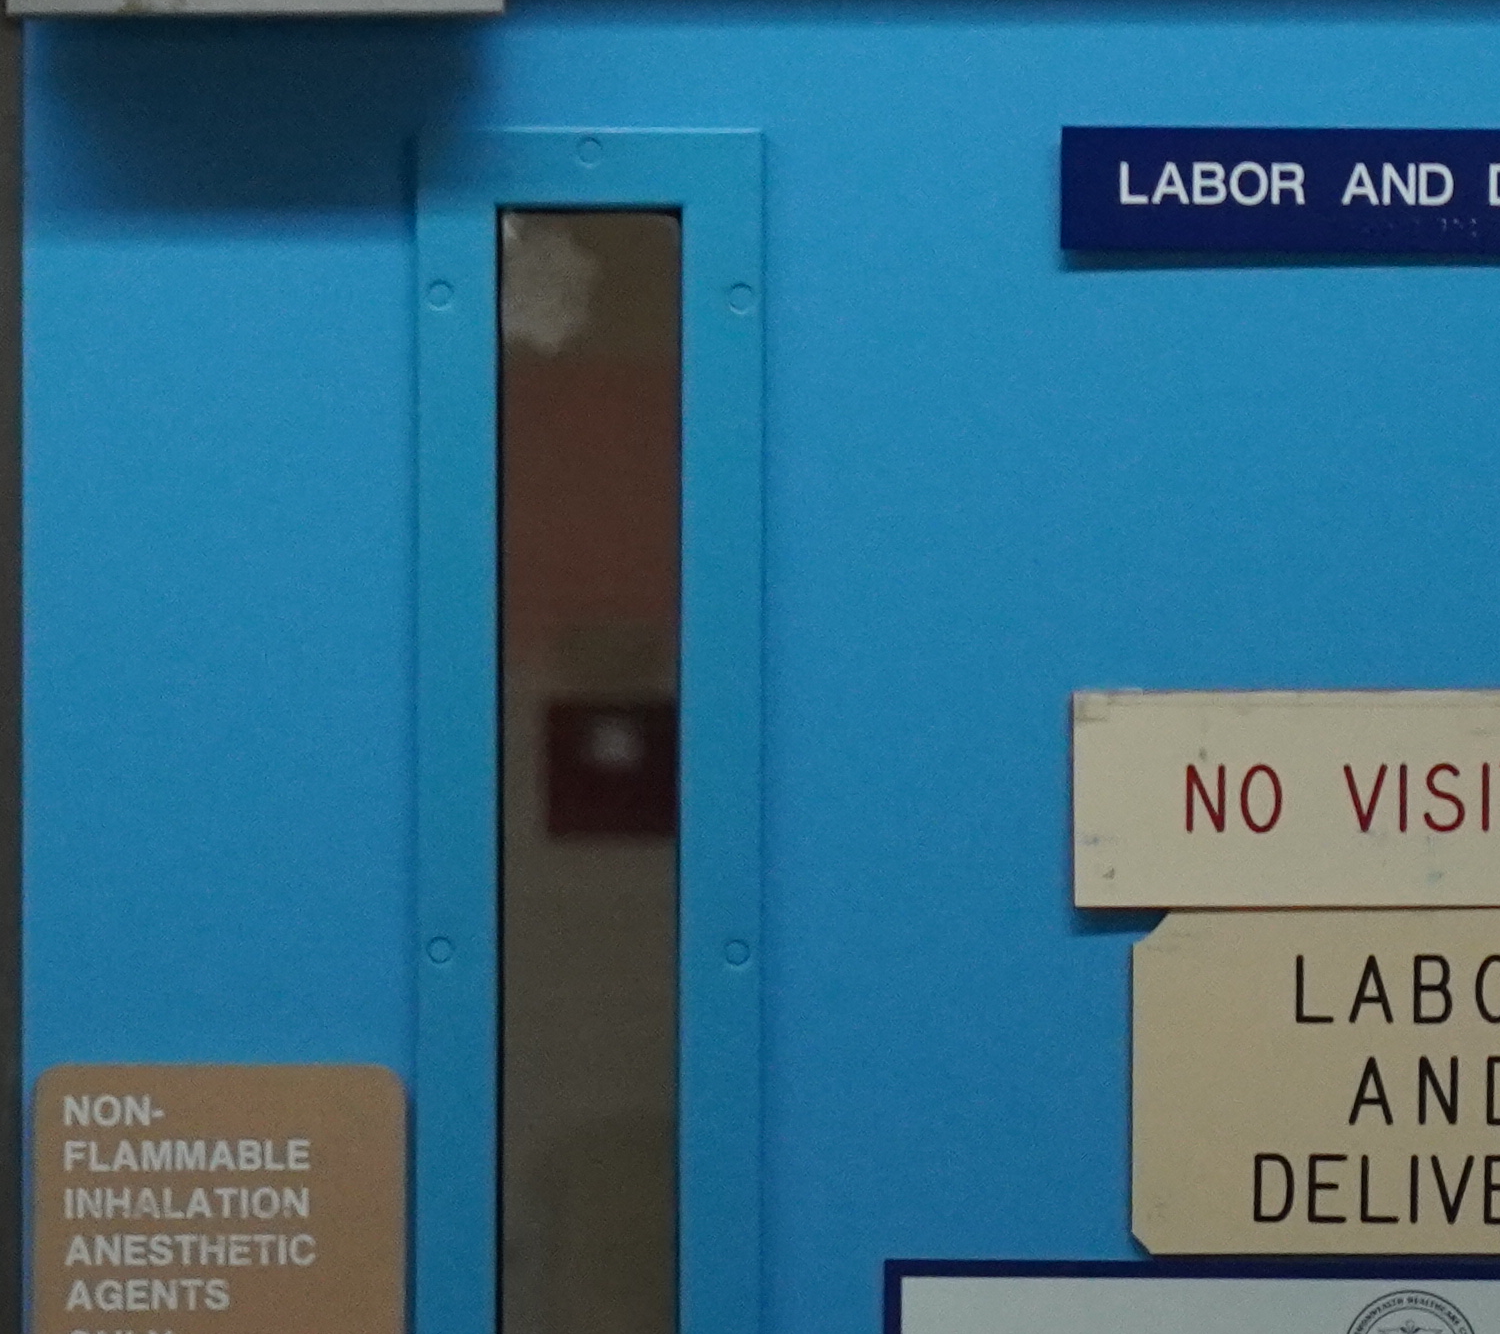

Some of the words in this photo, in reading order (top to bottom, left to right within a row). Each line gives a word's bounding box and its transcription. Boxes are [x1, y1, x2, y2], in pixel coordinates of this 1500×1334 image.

[1120, 161, 1305, 205] LABOR
[1342, 163, 1454, 206] AND
[1186, 764, 1282, 834] NO
[64, 1095, 164, 1126] NON-
[64, 1139, 309, 1175] FLAMMABLE
[65, 1187, 309, 1218] INHALATION
[65, 1233, 315, 1266] ANESTHETIC
[67, 1278, 232, 1311] AGENTS
